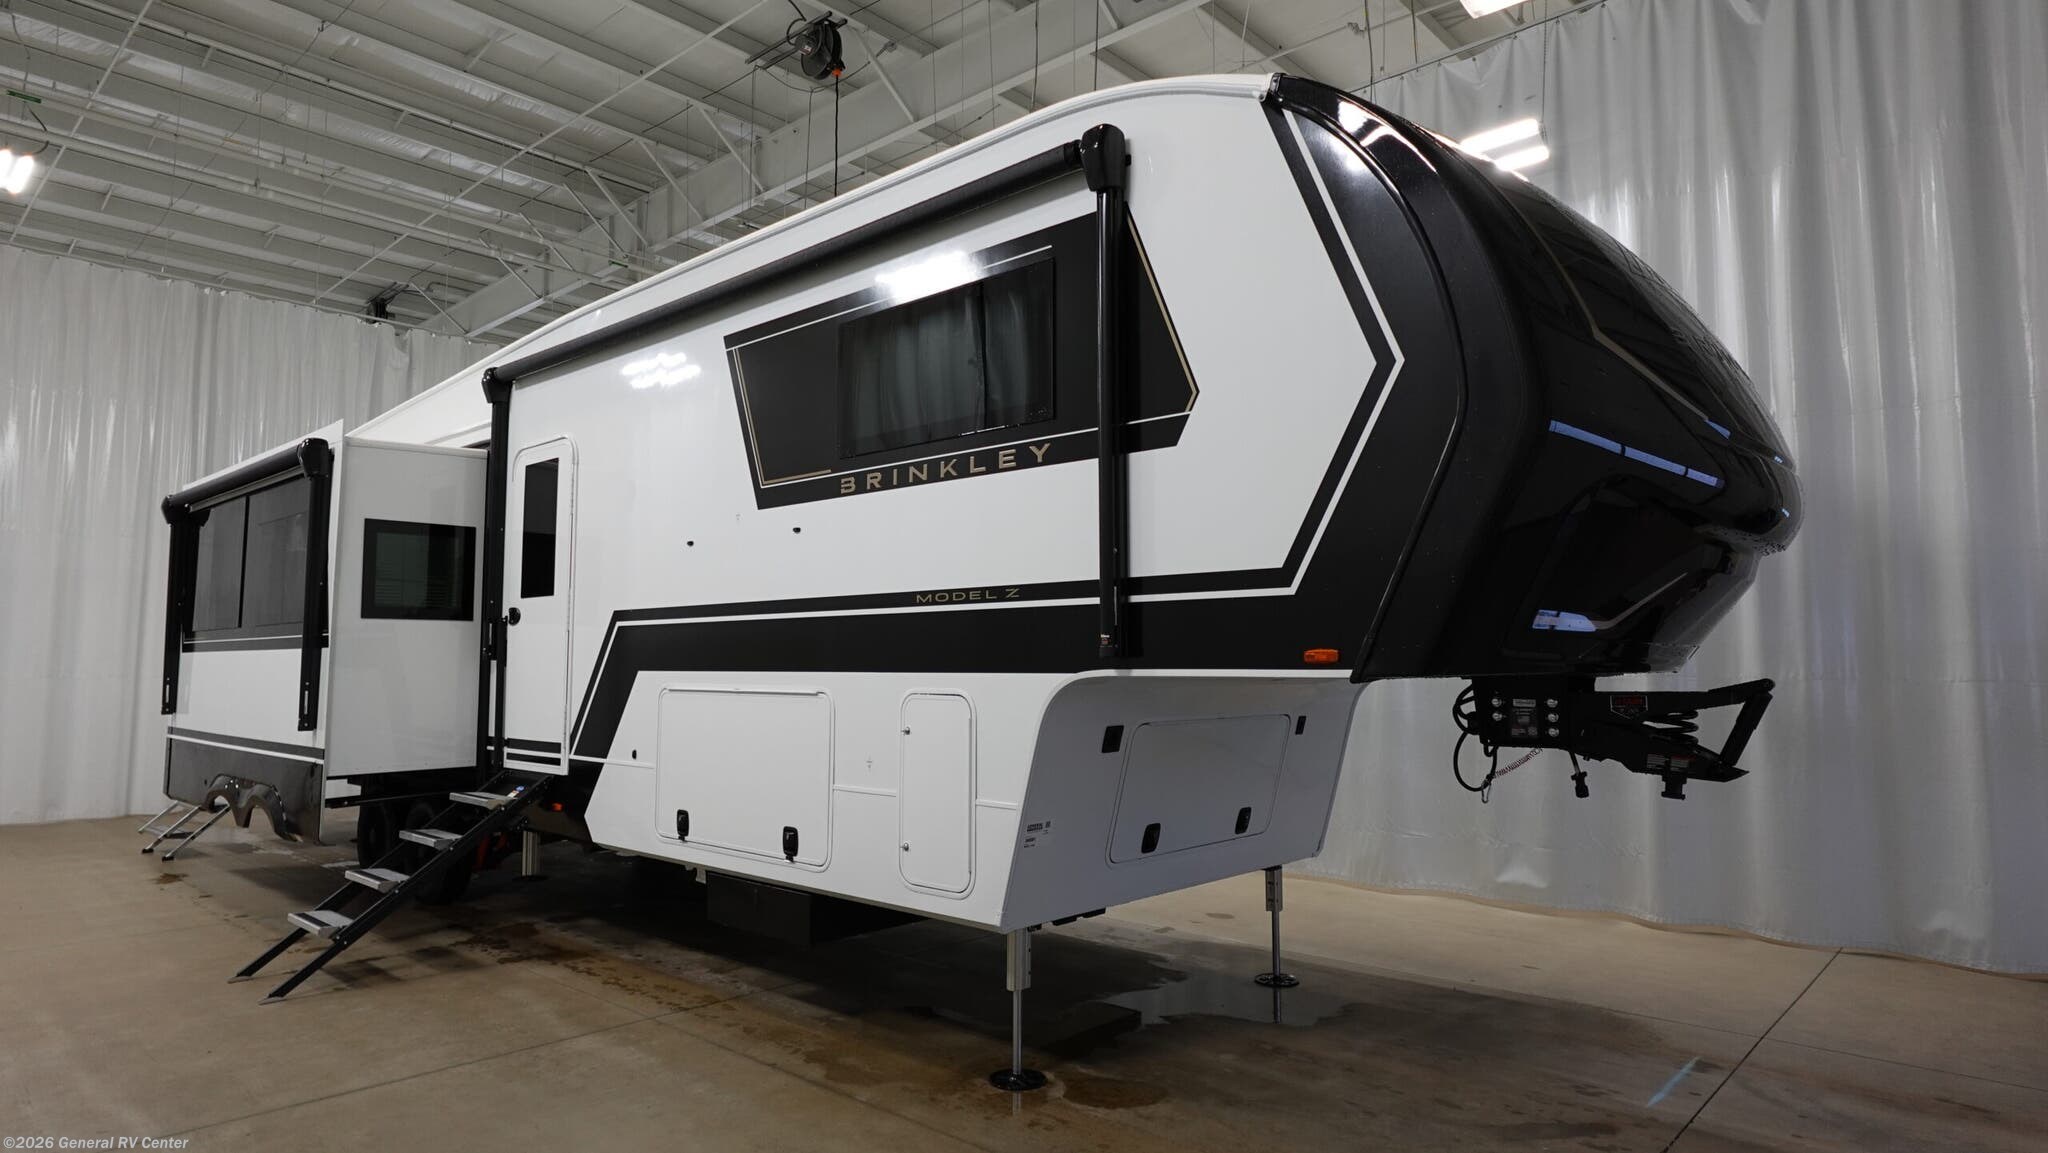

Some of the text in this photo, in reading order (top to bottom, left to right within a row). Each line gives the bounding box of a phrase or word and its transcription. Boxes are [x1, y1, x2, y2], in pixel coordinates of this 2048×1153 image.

[840, 443, 1051, 494] BRINKLEY
[916, 588, 1020, 603] MODEL Z
